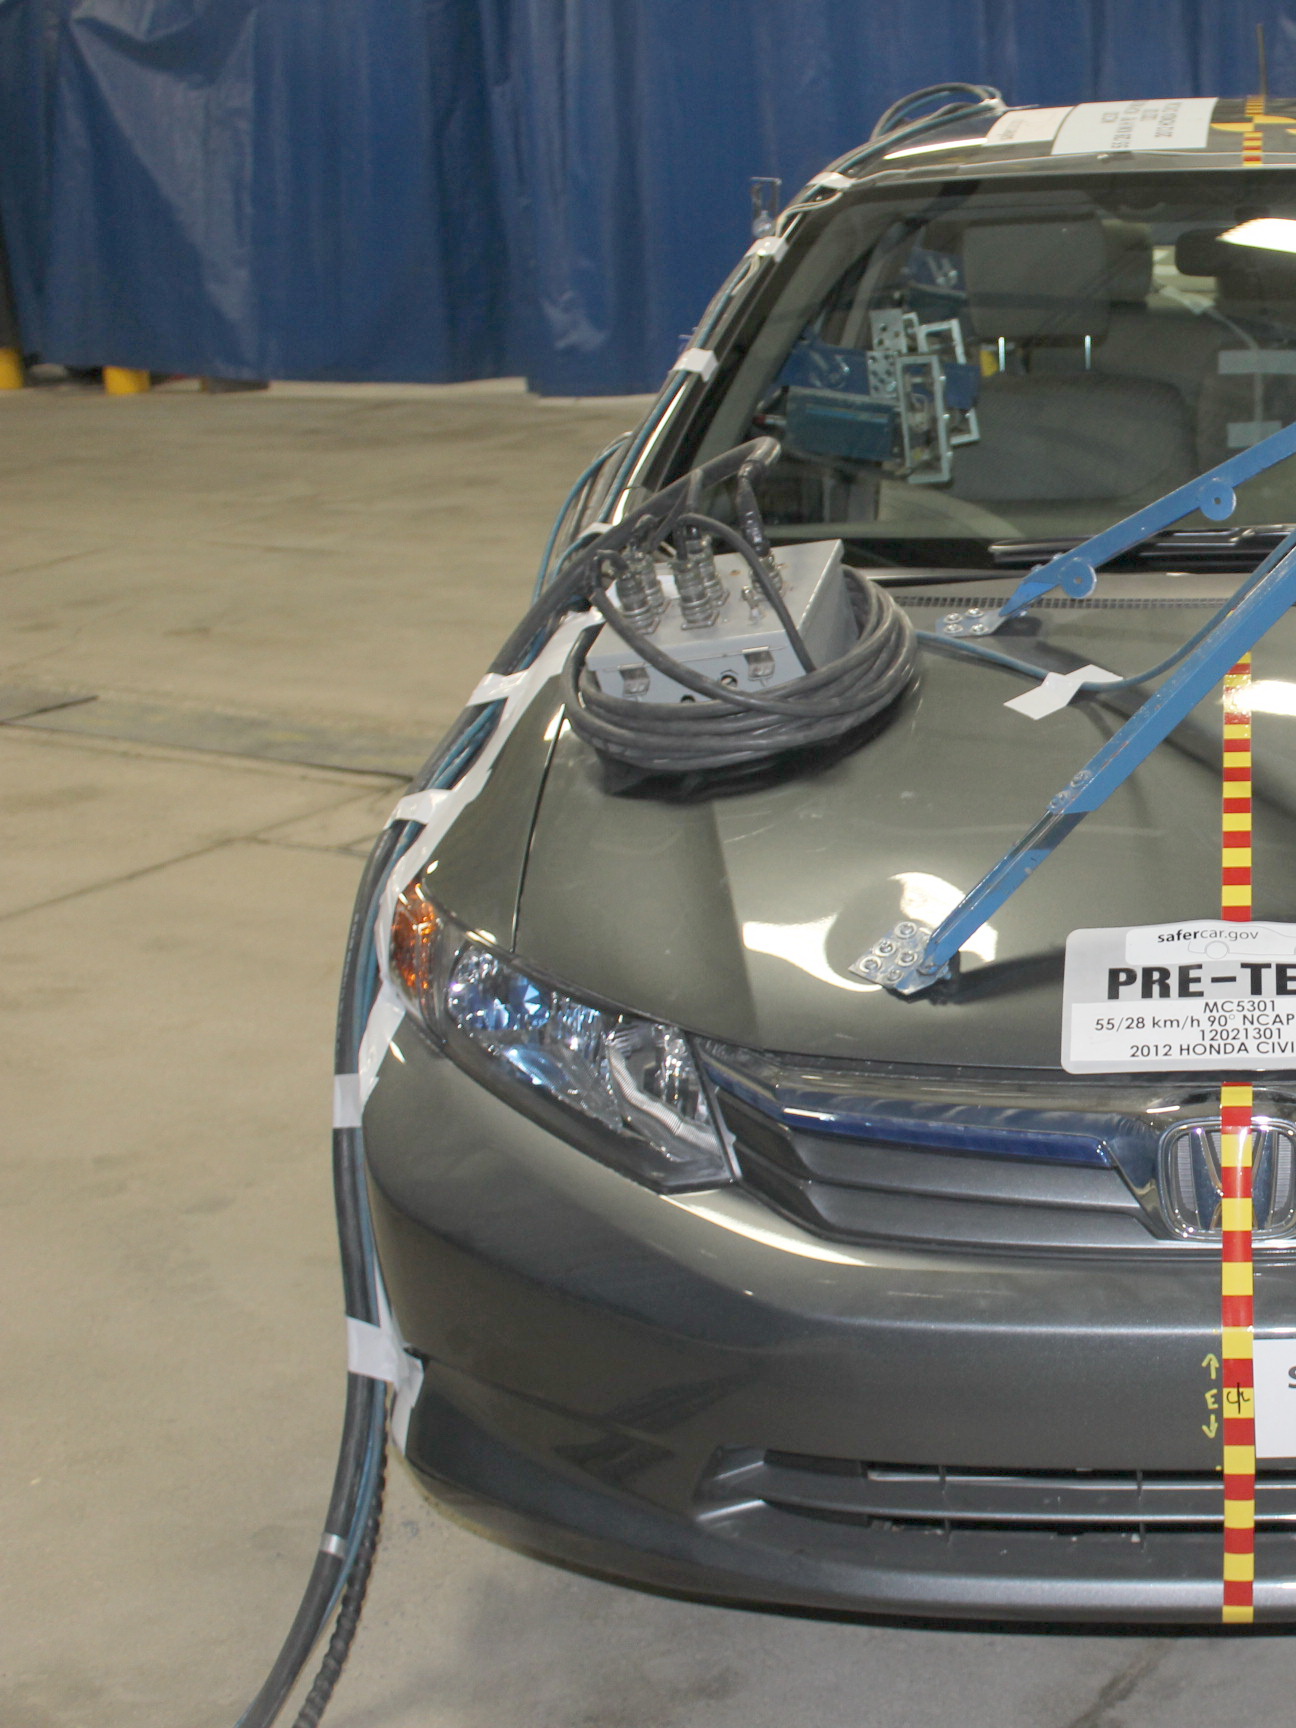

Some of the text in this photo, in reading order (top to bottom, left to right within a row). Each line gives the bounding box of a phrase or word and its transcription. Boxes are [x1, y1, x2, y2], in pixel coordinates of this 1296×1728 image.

[1157, 927, 1259, 943] safercar.gov
[1203, 1000, 1276, 1014] MC5301
[1095, 1016, 1146, 1032] 55/28
[1152, 1013, 1201, 1029] km/h
[1242, 1012, 1296, 1027] NCAP
[1199, 1027, 1283, 1042] 12021301
[1129, 1043, 1173, 1058] 2012
[1179, 1041, 1249, 1056] HONDA
